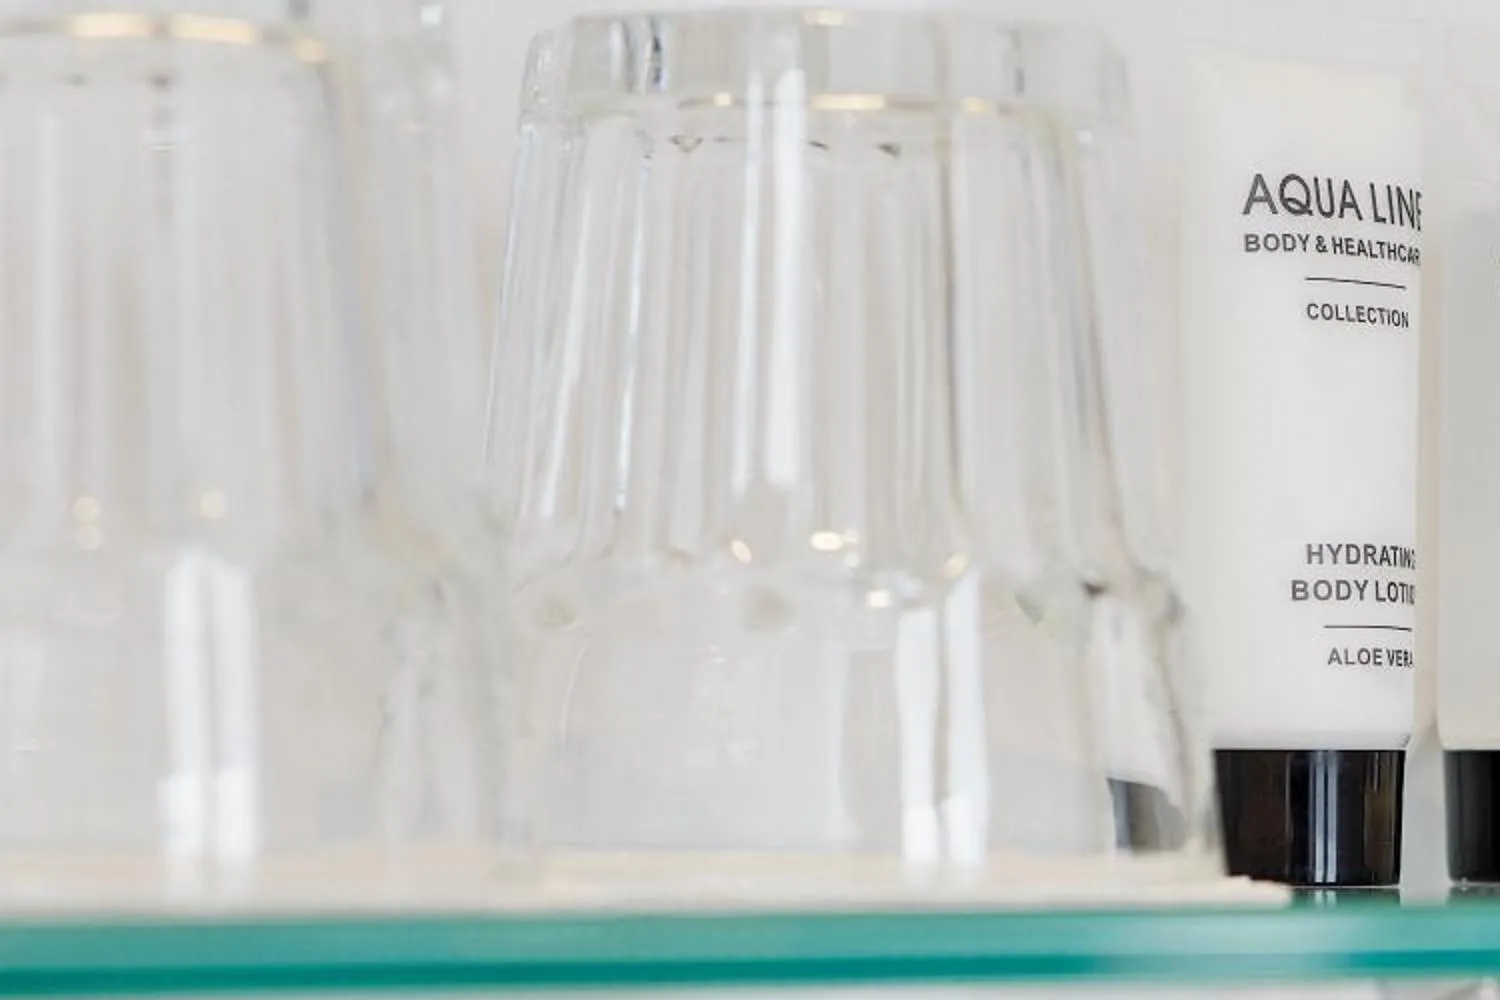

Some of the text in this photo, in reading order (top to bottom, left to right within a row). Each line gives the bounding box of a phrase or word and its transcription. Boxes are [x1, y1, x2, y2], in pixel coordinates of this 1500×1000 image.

[1242, 173, 1363, 221] AQUA
[1244, 233, 1310, 252] BODY
[1315, 236, 1328, 253] &
[1306, 303, 1409, 328] COLLECTION
[1291, 579, 1369, 602] BODY
[1327, 647, 1383, 666] ALOE
